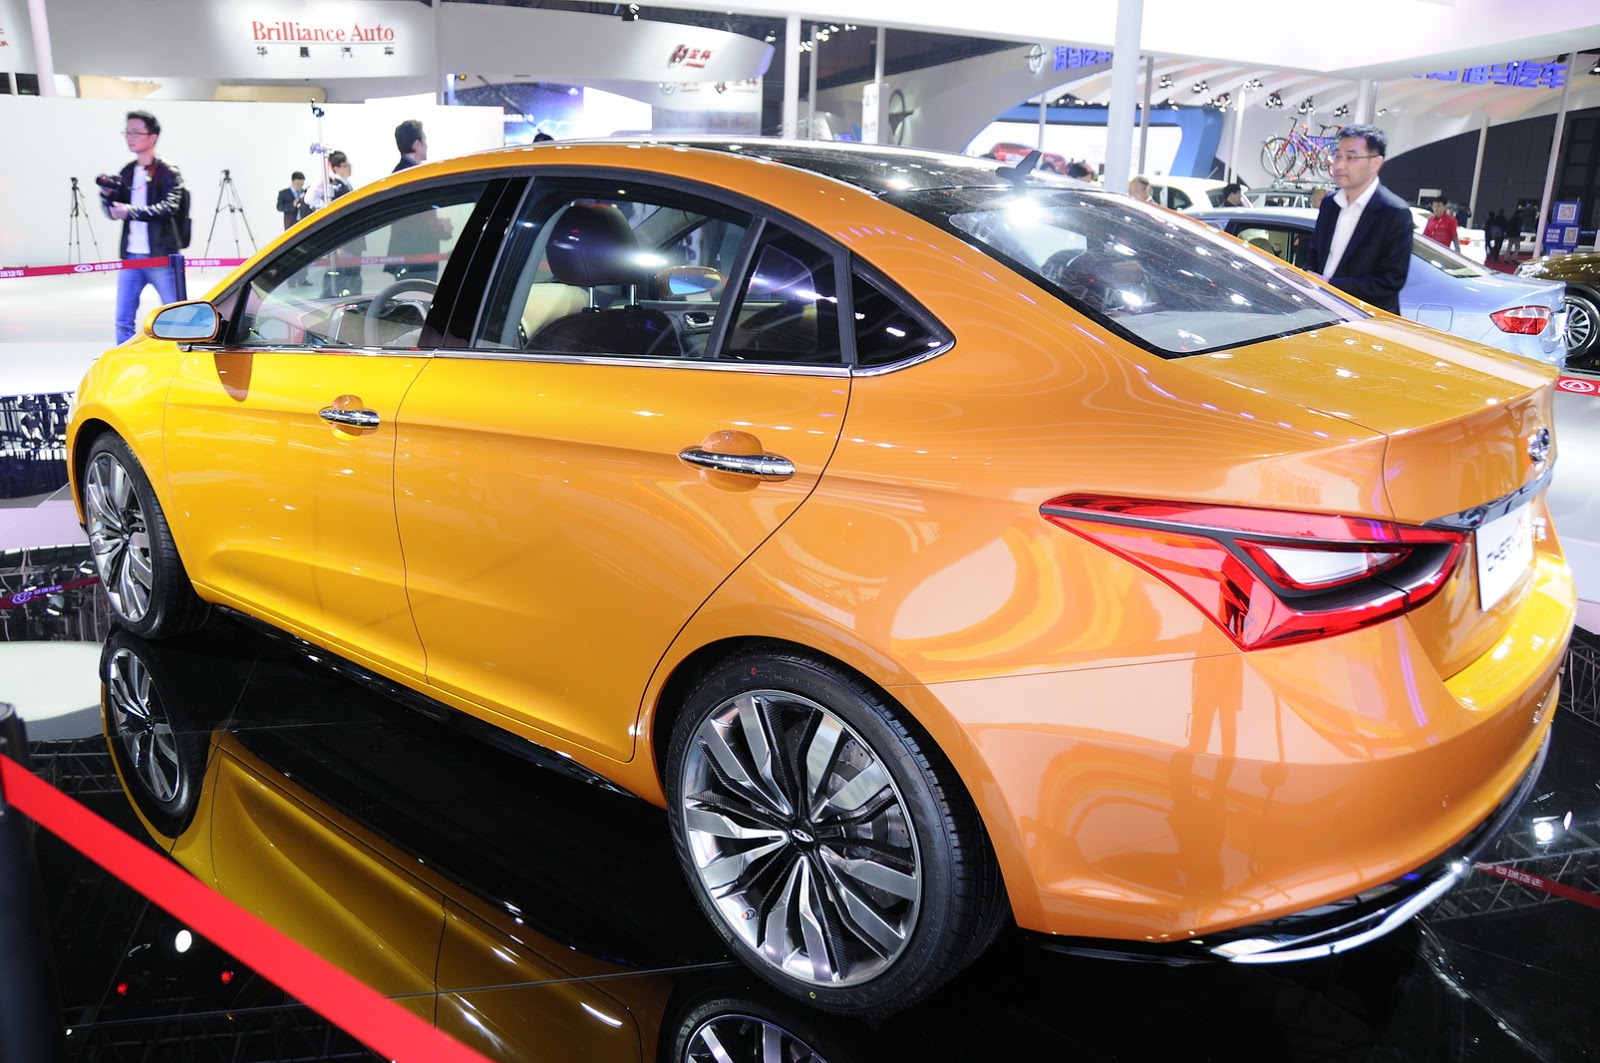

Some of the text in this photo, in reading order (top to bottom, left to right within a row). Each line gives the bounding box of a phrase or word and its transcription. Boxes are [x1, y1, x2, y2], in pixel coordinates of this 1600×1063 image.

[252, 21, 395, 42] Brilliance Auto
[256, 46, 395, 58] 华晨汽车
